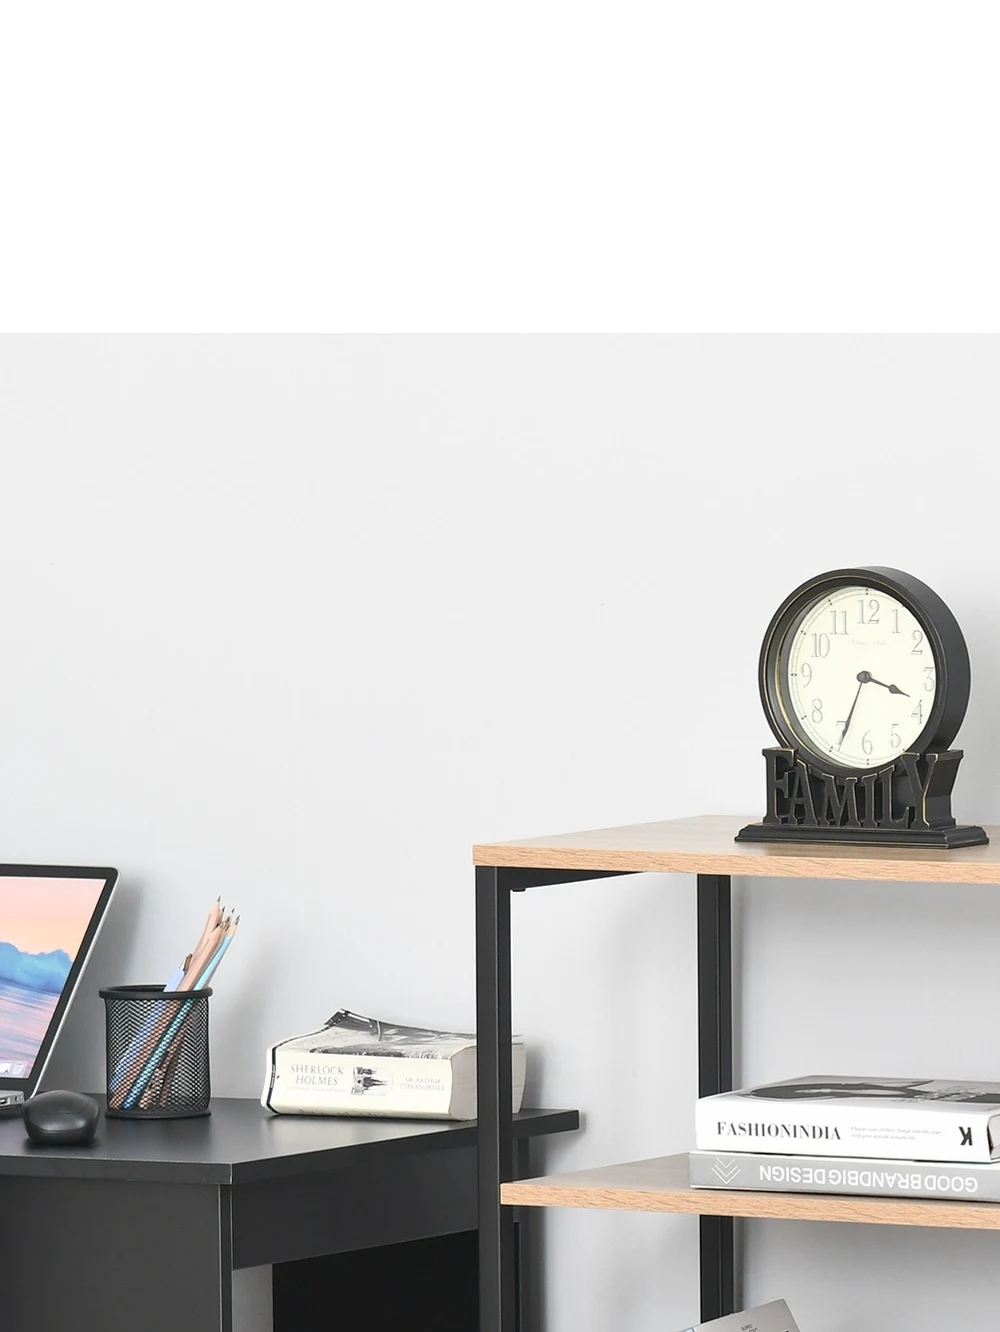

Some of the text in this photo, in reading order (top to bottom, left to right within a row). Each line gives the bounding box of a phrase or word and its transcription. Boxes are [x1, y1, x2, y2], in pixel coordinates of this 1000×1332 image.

[830, 610, 850, 635] 11
[857, 599, 880, 624] 12
[891, 609, 901, 634] 1
[810, 632, 830, 658] 10
[911, 629, 924, 655] 2
[800, 663, 812, 688] 9
[923, 667, 935, 692] 3
[811, 698, 823, 724] 8
[911, 699, 923, 724] 4
[861, 730, 873, 755] 6
[890, 723, 902, 749] 5
[762, 748, 945, 829] FAMILY
[290, 1063, 344, 1075] SHERLOCK
[295, 1075, 339, 1086] HOLMES
[716, 1121, 841, 1141] FASHIONINDIA
[958, 1126, 973, 1146] K
[759, 1164, 978, 1193] GOOD BRANDBIG DESIGN
